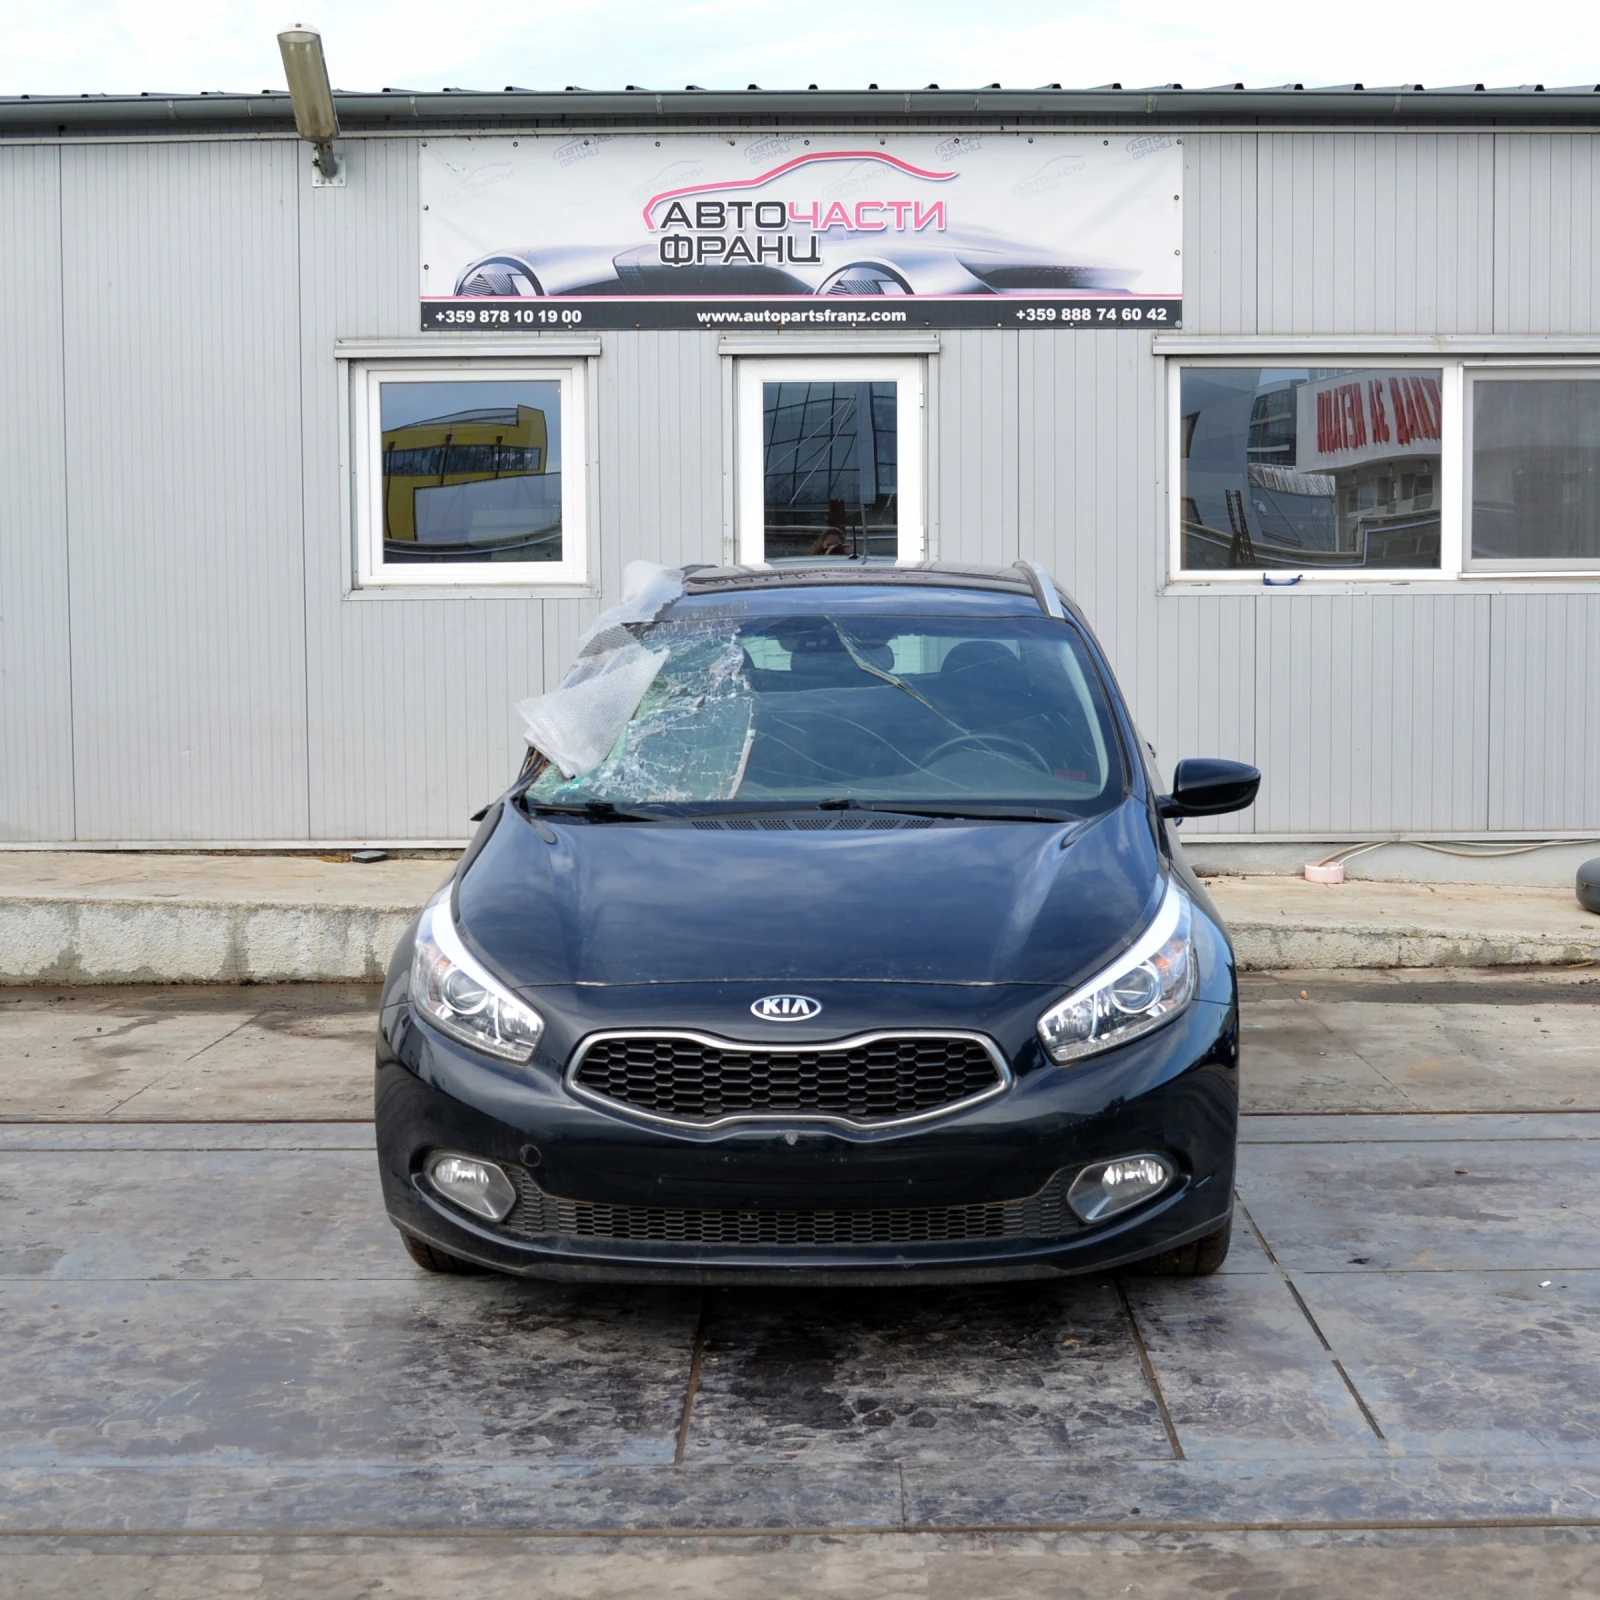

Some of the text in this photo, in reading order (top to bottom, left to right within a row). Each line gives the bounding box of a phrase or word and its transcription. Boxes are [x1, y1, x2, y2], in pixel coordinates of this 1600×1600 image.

[560, 147, 600, 168] ФРАНЦ
[750, 144, 792, 165] ФРАНЦ
[942, 142, 982, 163] ФРАНЦ
[1133, 140, 1173, 162] ФРАНЦ
[660, 202, 945, 229] АВТОЧАСТИ
[659, 234, 821, 265] ФРАНЦ
[435, 310, 582, 323] +359 878 10 19 00
[696, 309, 907, 325] www.autopartsfranz.com
[1016, 308, 1167, 321] +359 888 74 60 42
[762, 998, 811, 1014] KIA
